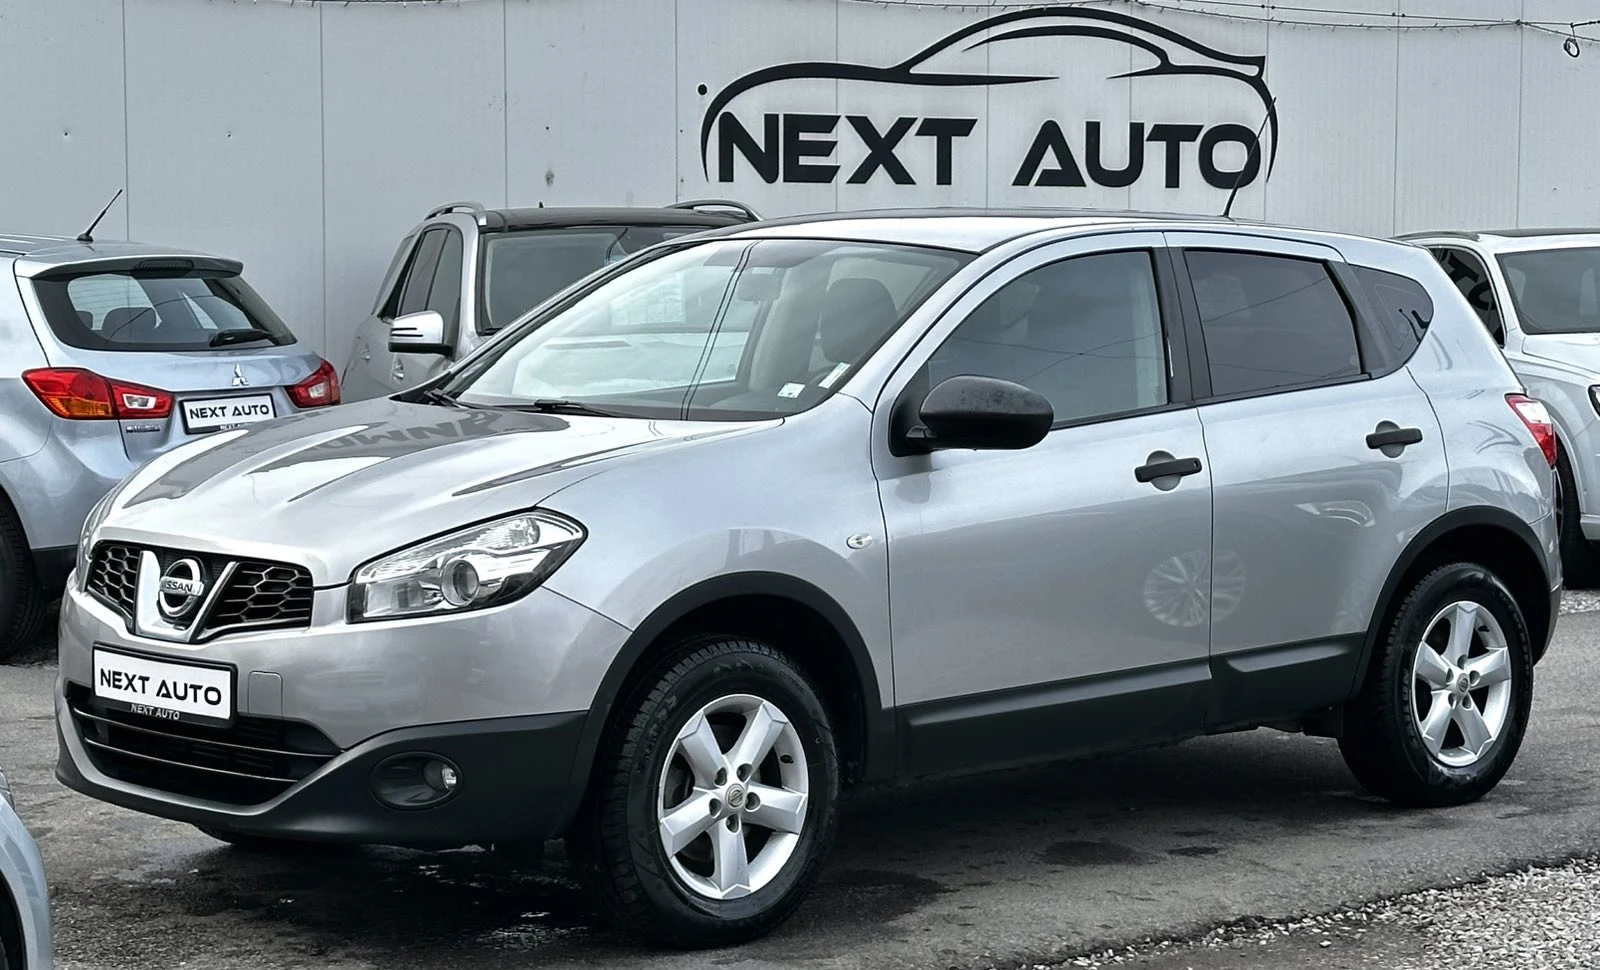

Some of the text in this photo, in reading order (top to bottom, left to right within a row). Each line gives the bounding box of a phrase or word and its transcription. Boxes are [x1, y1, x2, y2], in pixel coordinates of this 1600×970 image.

[719, 112, 1260, 189] NEXT AUTO
[189, 404, 270, 420] NEXT AUTO
[100, 668, 222, 706] NEXT AUTO
[130, 703, 180, 721] NEXT AUTO
